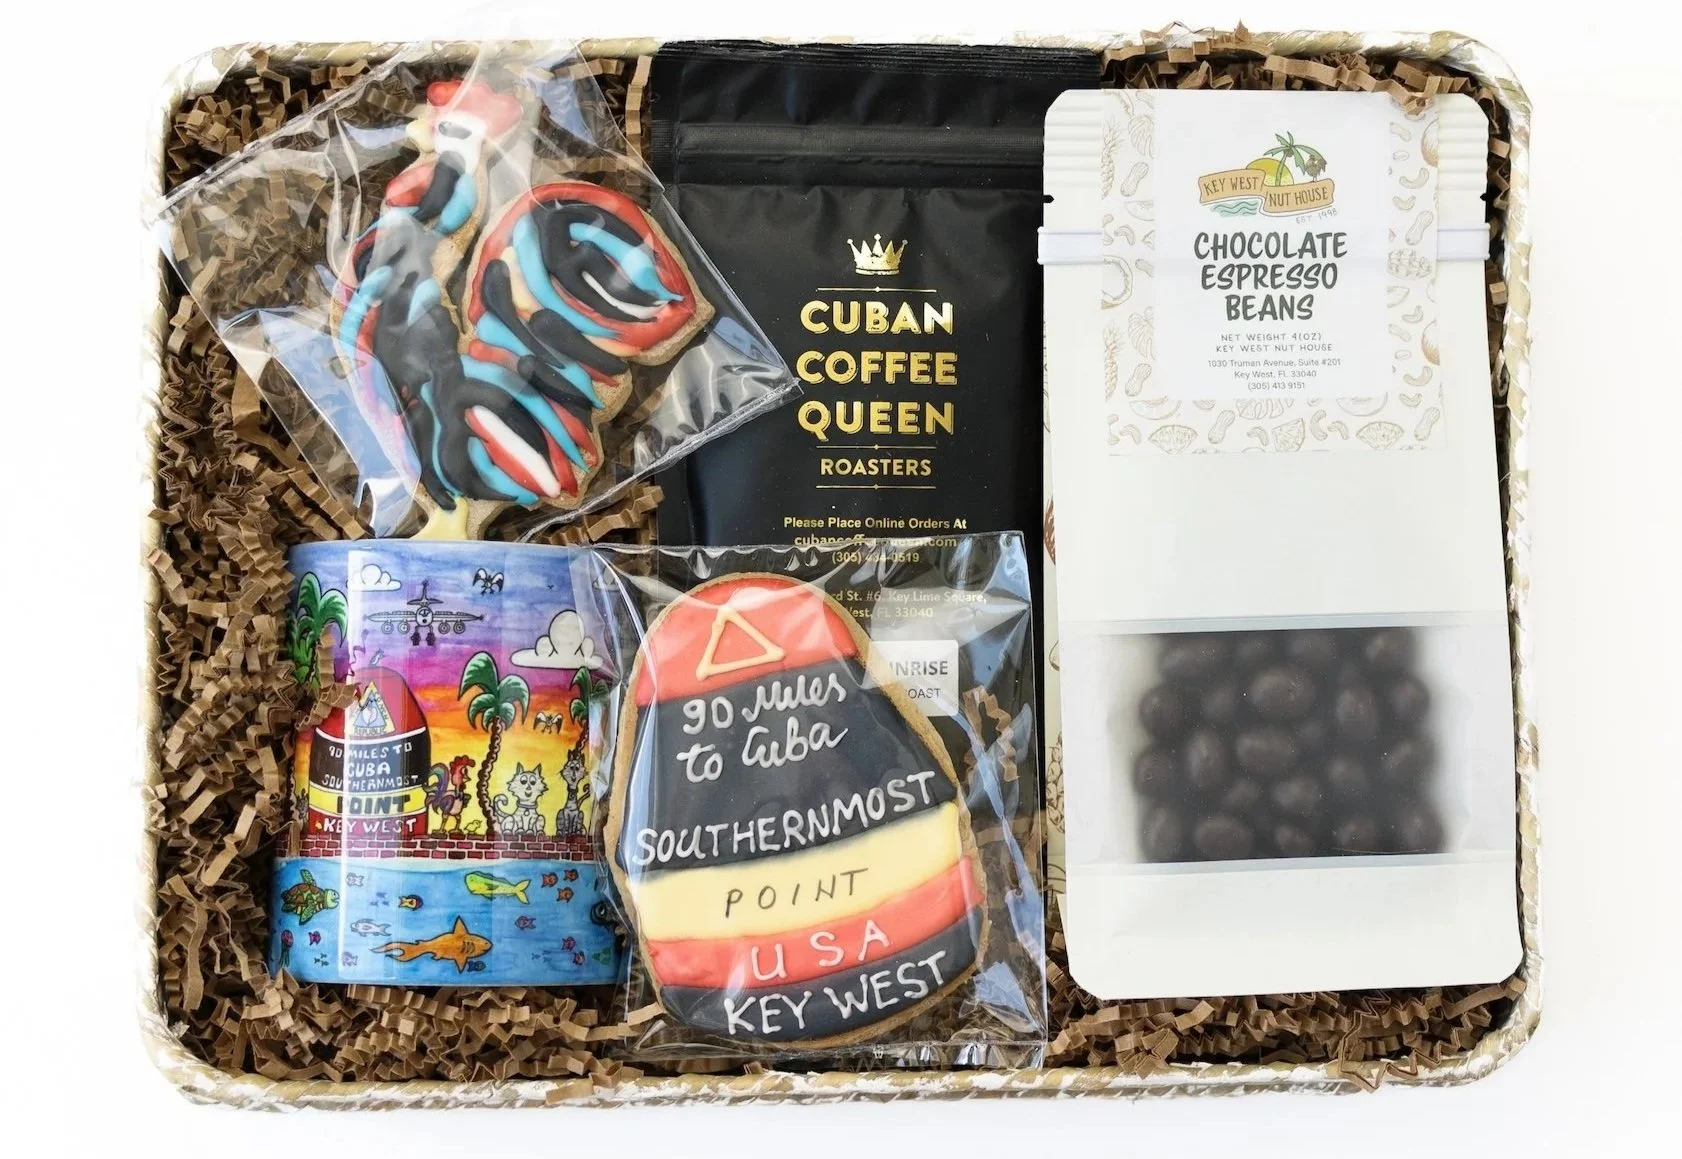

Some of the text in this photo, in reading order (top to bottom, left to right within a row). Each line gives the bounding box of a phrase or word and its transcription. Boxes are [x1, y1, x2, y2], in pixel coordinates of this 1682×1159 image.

[1203, 176, 1259, 196] KEY WEST
[1268, 187, 1329, 207] NUT HOUSE
[1193, 231, 1348, 261] CHOCOLATE
[1201, 263, 1338, 290] ESPRESSO
[1225, 294, 1314, 321] BEANS
[800, 300, 954, 335] CUBAN
[1221, 333, 1240, 342] NET
[1246, 332, 1287, 342] WEIGHT
[1216, 343, 1333, 353] KEY WEST NUT HOUSE
[796, 350, 957, 385] COFFEE
[1208, 358, 1341, 369] 1030 Truman Avenue, Suite #201
[1234, 370, 1250, 380] Key
[1291, 370, 1317, 378] 33040
[1247, 381, 1305, 391] (305) 413 9151
[797, 400, 955, 442] QUEEN
[820, 458, 932, 476] ROASTERS
[783, 516, 967, 529] Please Place Online Orders At
[832, 551, 862, 565] (305)
[846, 590, 863, 602] St.
[888, 590, 910, 605] Key
[913, 590, 941, 602] Lime
[895, 607, 933, 618] 33040
[907, 687, 941, 699] OAST
[682, 696, 734, 735] 90
[347, 747, 389, 759] MILES
[676, 716, 849, 783] to Cuba
[347, 761, 391, 778] CUBA
[362, 818, 417, 833] WEST
[631, 770, 936, 866] SOUTHERNMOST
[724, 867, 869, 918] POINT
[723, 950, 946, 1036] KEY WEST
